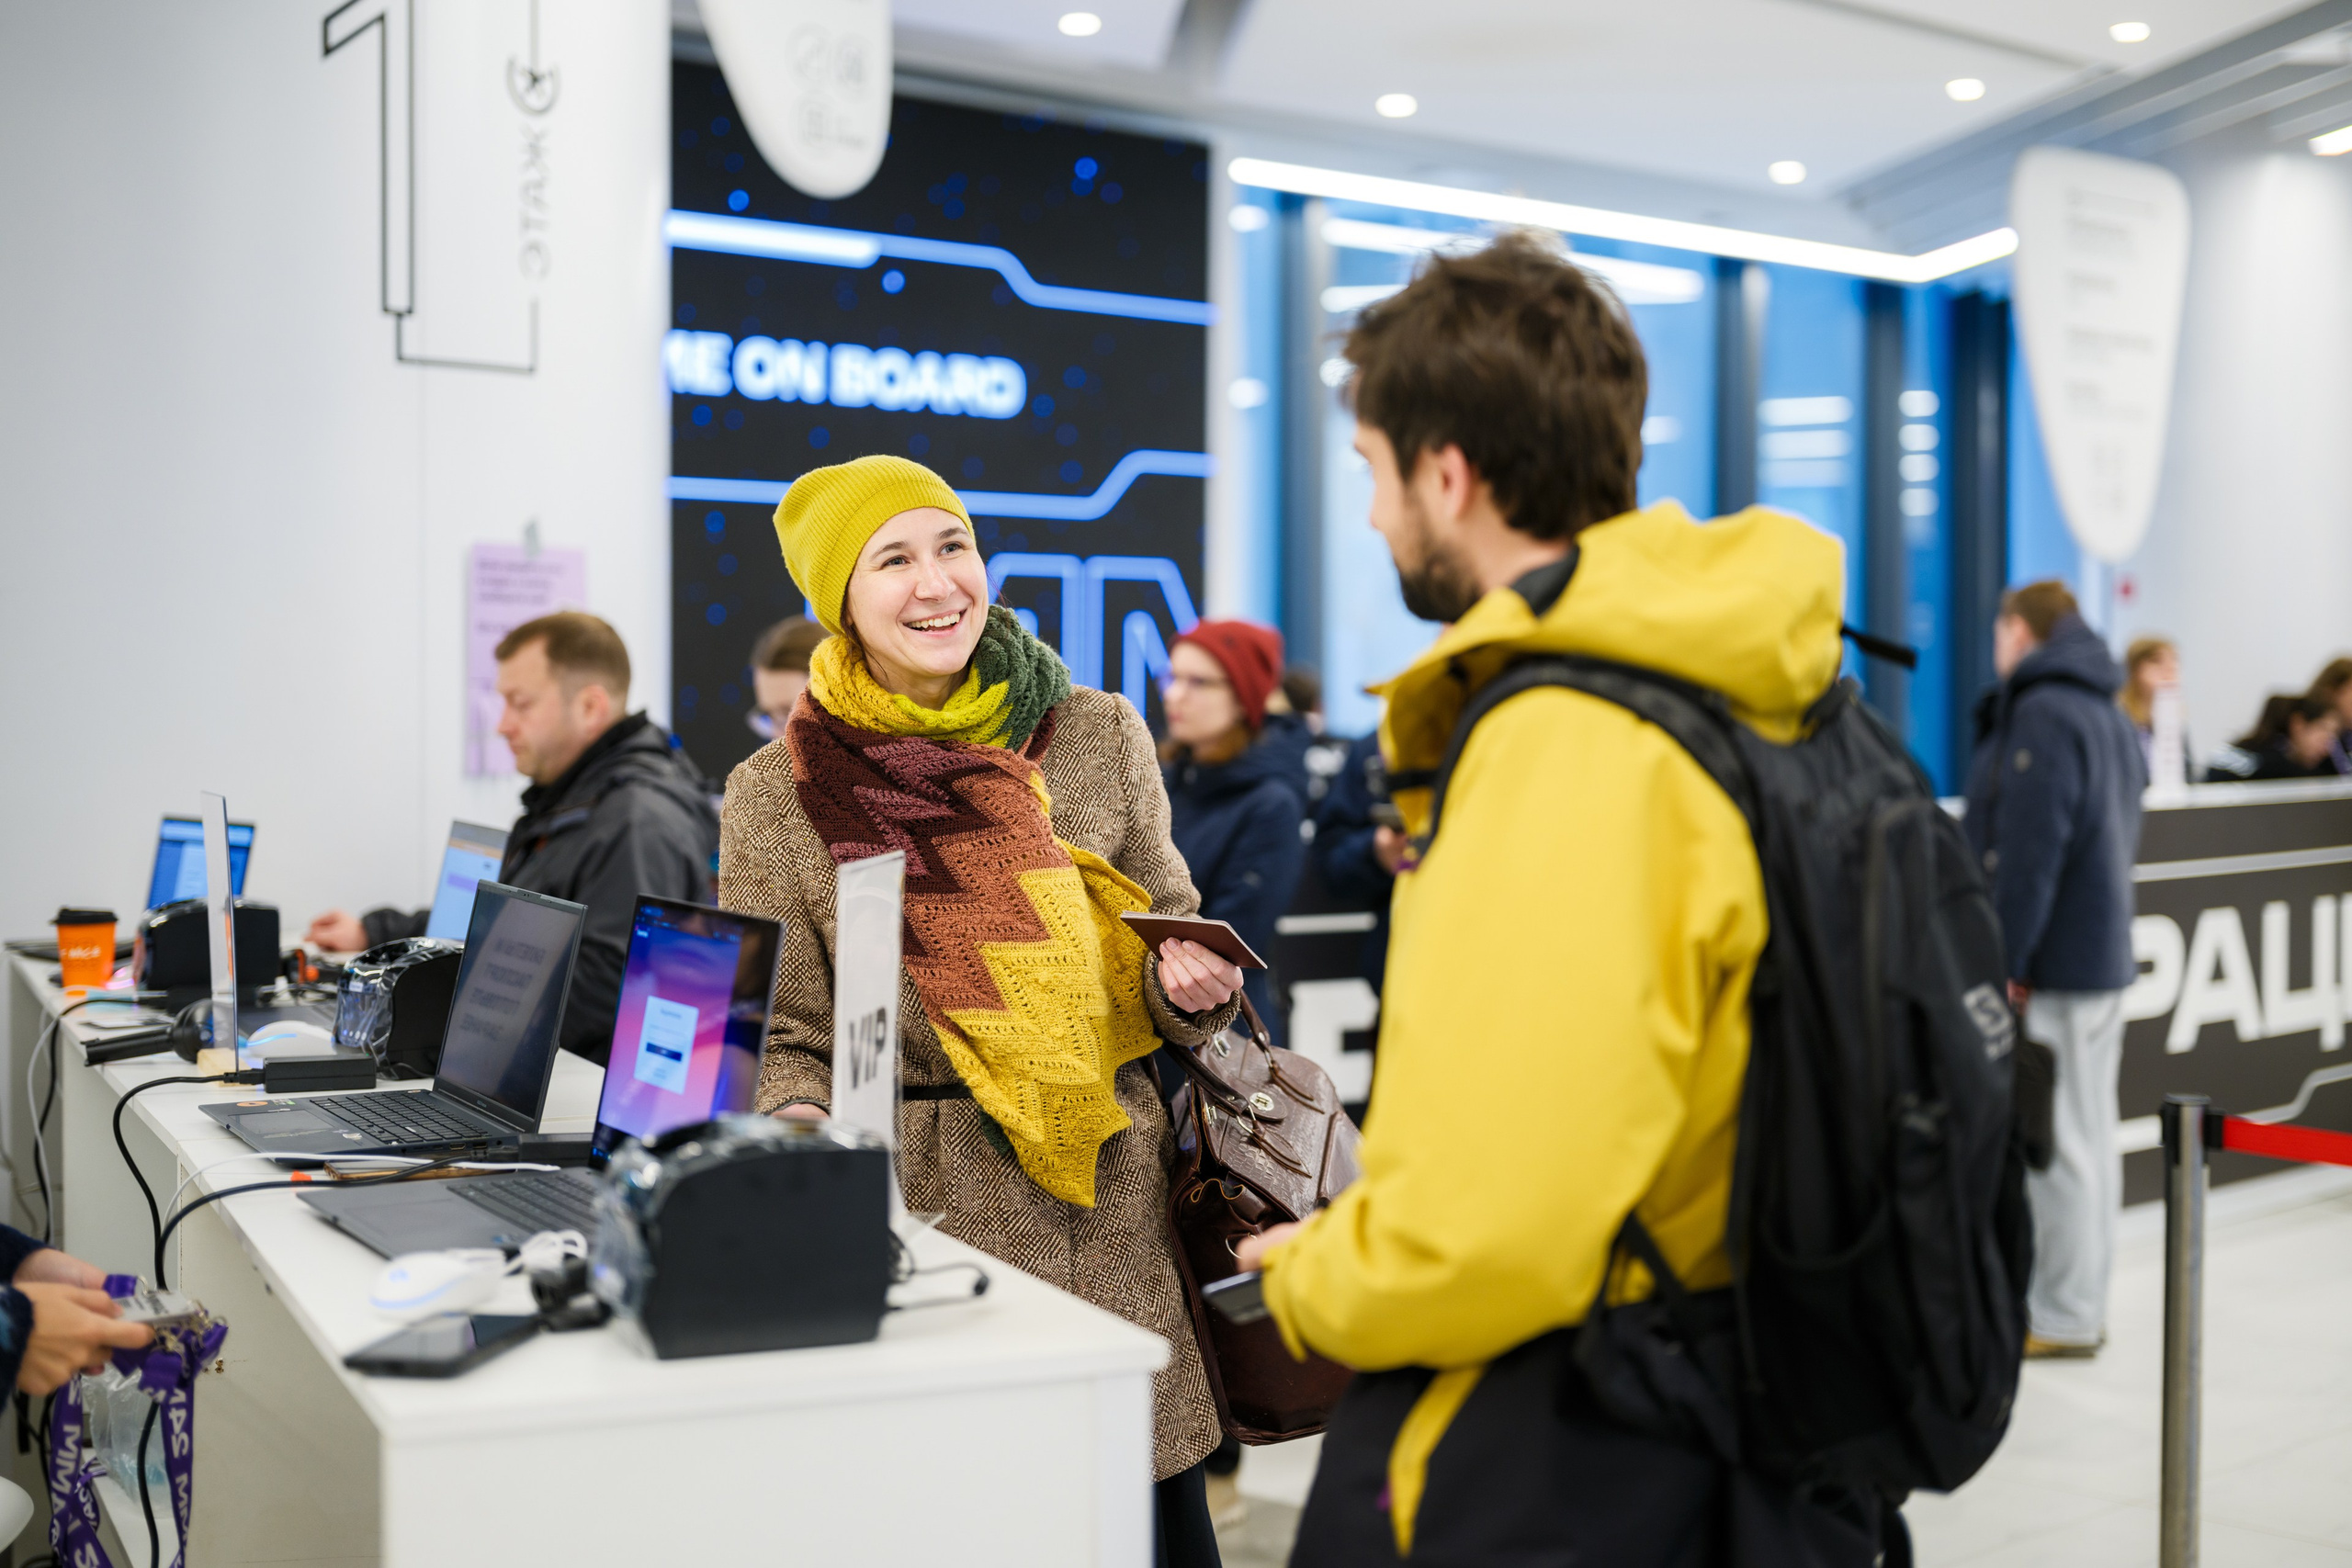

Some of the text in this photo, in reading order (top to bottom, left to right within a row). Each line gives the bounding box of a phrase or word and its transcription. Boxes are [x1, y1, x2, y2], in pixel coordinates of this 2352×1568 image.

[735, 335, 829, 404] ON
[829, 343, 1026, 419] BOARD
[2121, 893, 2352, 1055] РАЦ
[849, 1006, 887, 1090] VIP
